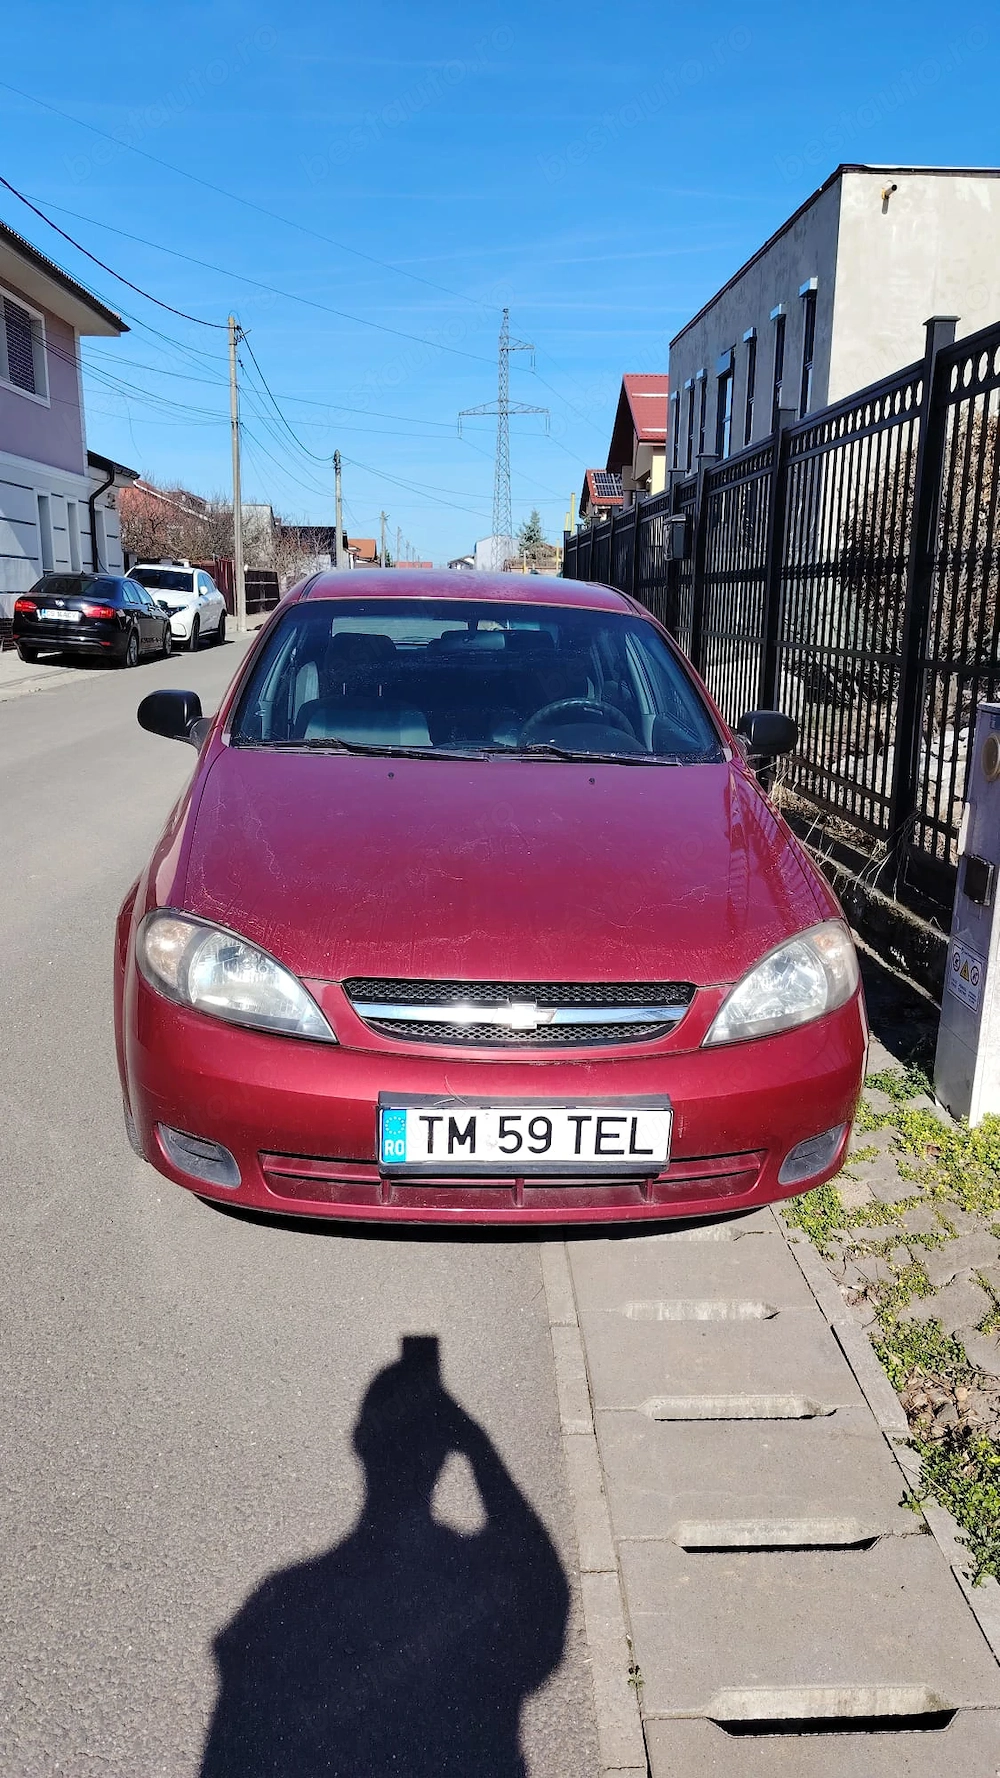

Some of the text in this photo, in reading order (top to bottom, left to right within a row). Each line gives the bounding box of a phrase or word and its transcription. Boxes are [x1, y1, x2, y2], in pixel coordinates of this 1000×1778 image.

[384, 1139, 405, 1156] RO
[418, 1115, 654, 1156] TM 59 TEL
